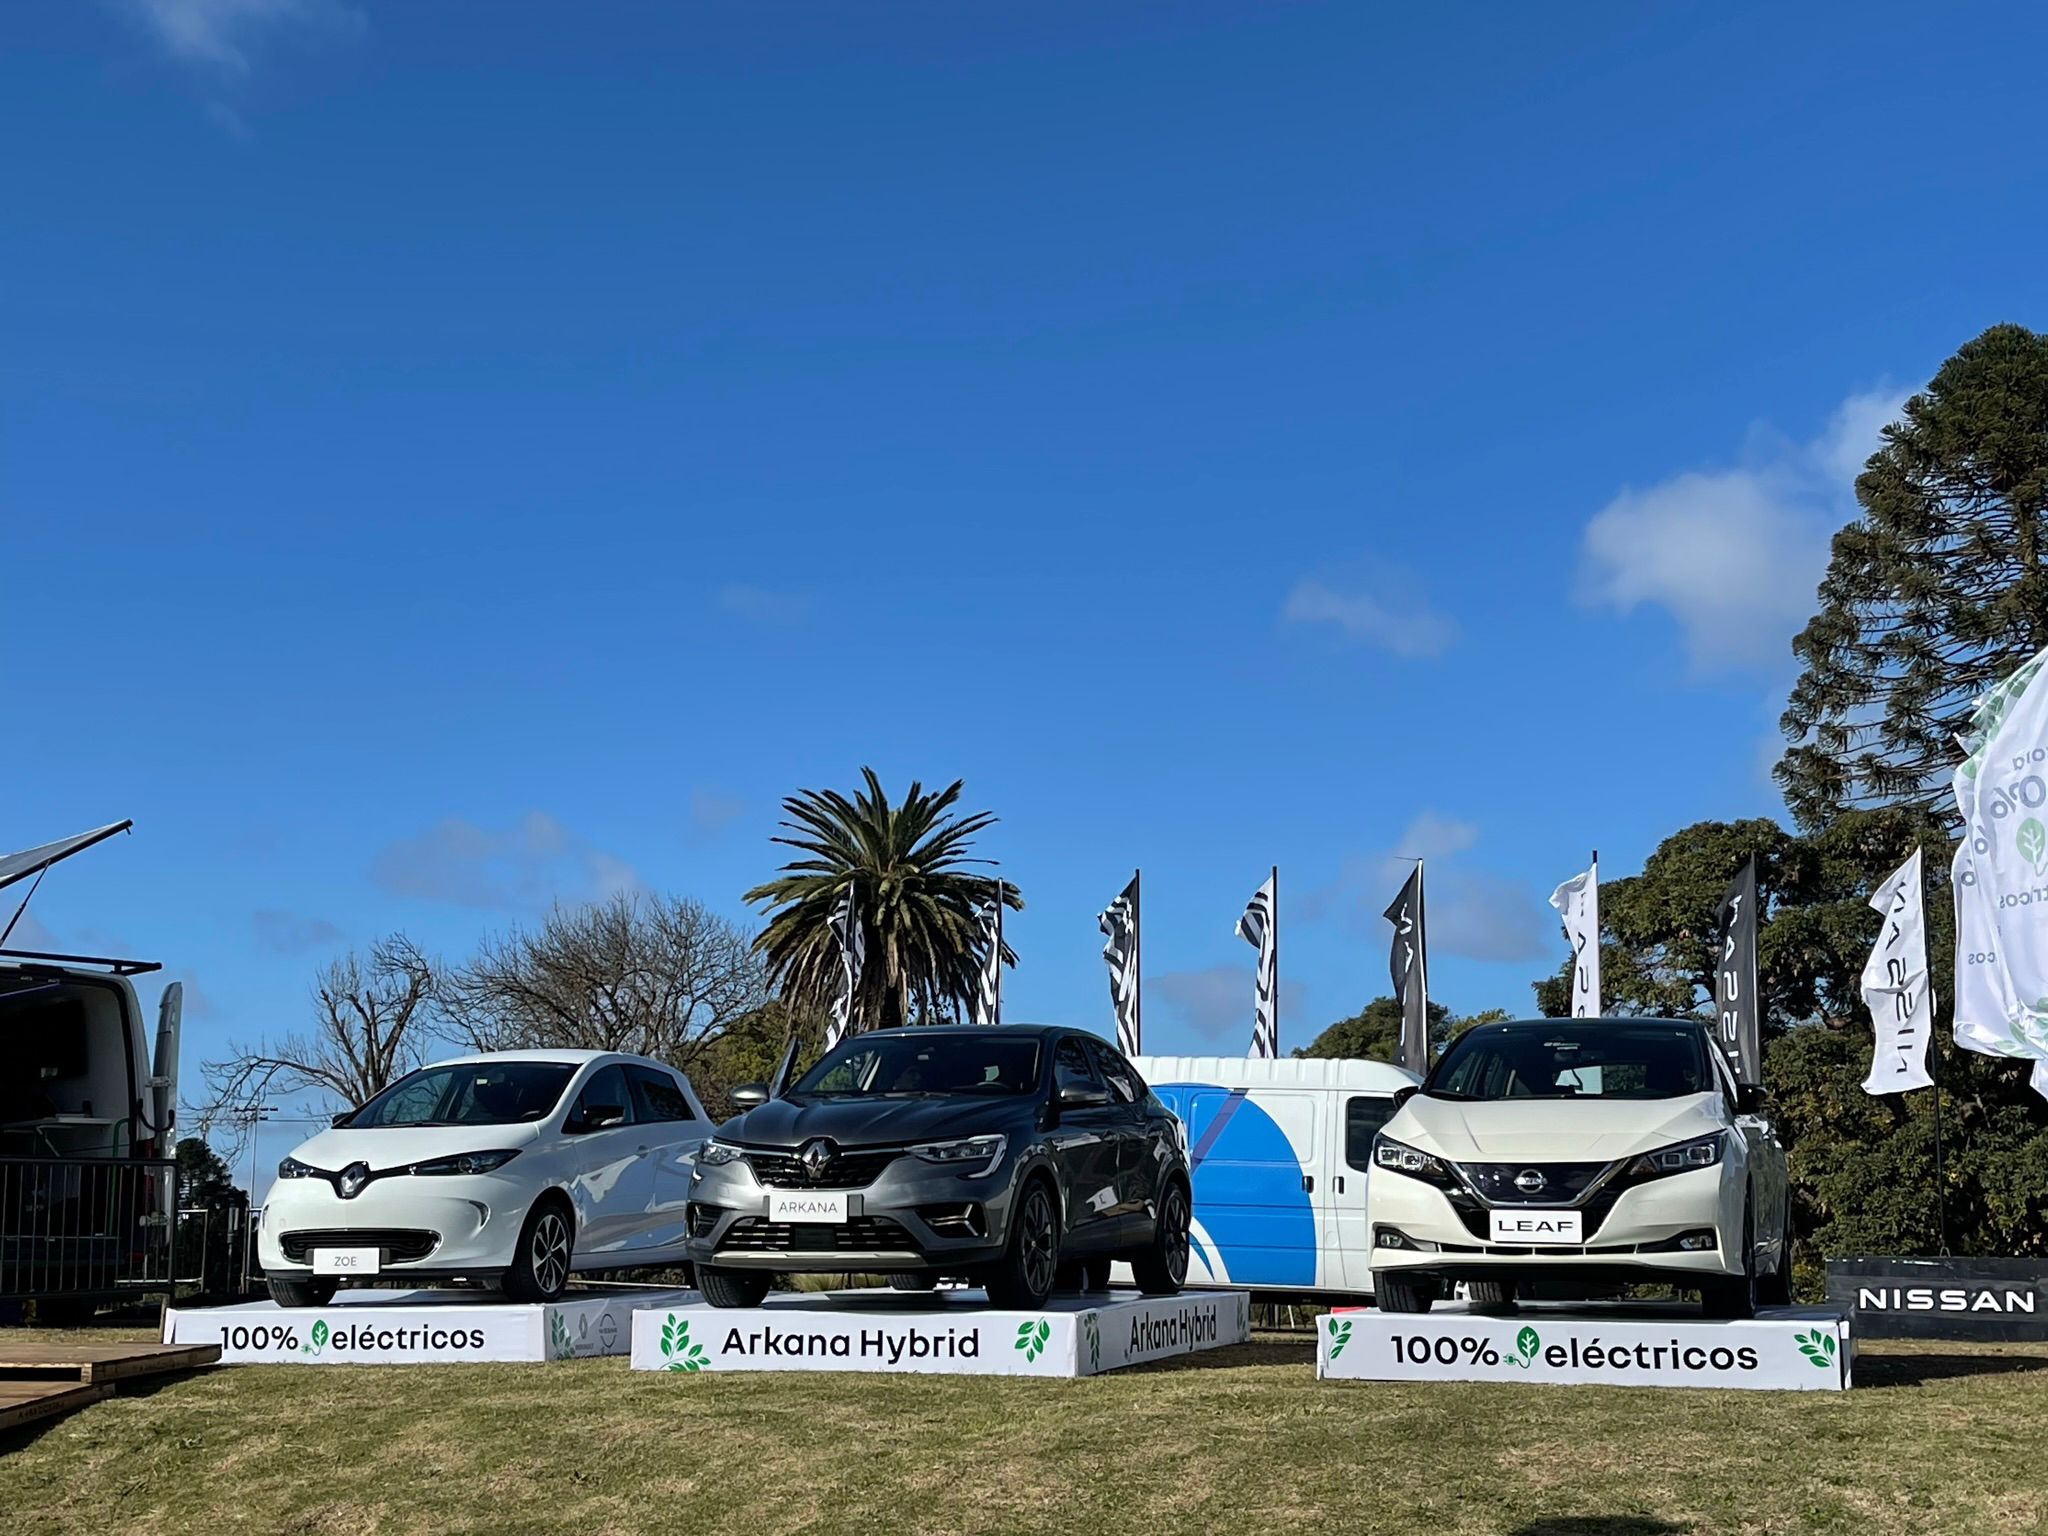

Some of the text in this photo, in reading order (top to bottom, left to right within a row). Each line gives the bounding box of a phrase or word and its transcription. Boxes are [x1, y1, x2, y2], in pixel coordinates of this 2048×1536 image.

[778, 1201, 838, 1214] ARKANA
[1498, 1220, 1573, 1233] LEAF
[334, 1256, 357, 1267] ZOE
[1859, 1288, 2035, 1313] NISSAN
[220, 1323, 485, 1351] 100% eléctricos
[1130, 1304, 1217, 1354] Arkana Hybrid
[721, 1326, 979, 1365] Arkana Hybrid
[1390, 1335, 1759, 1371] 100% eléctricos
